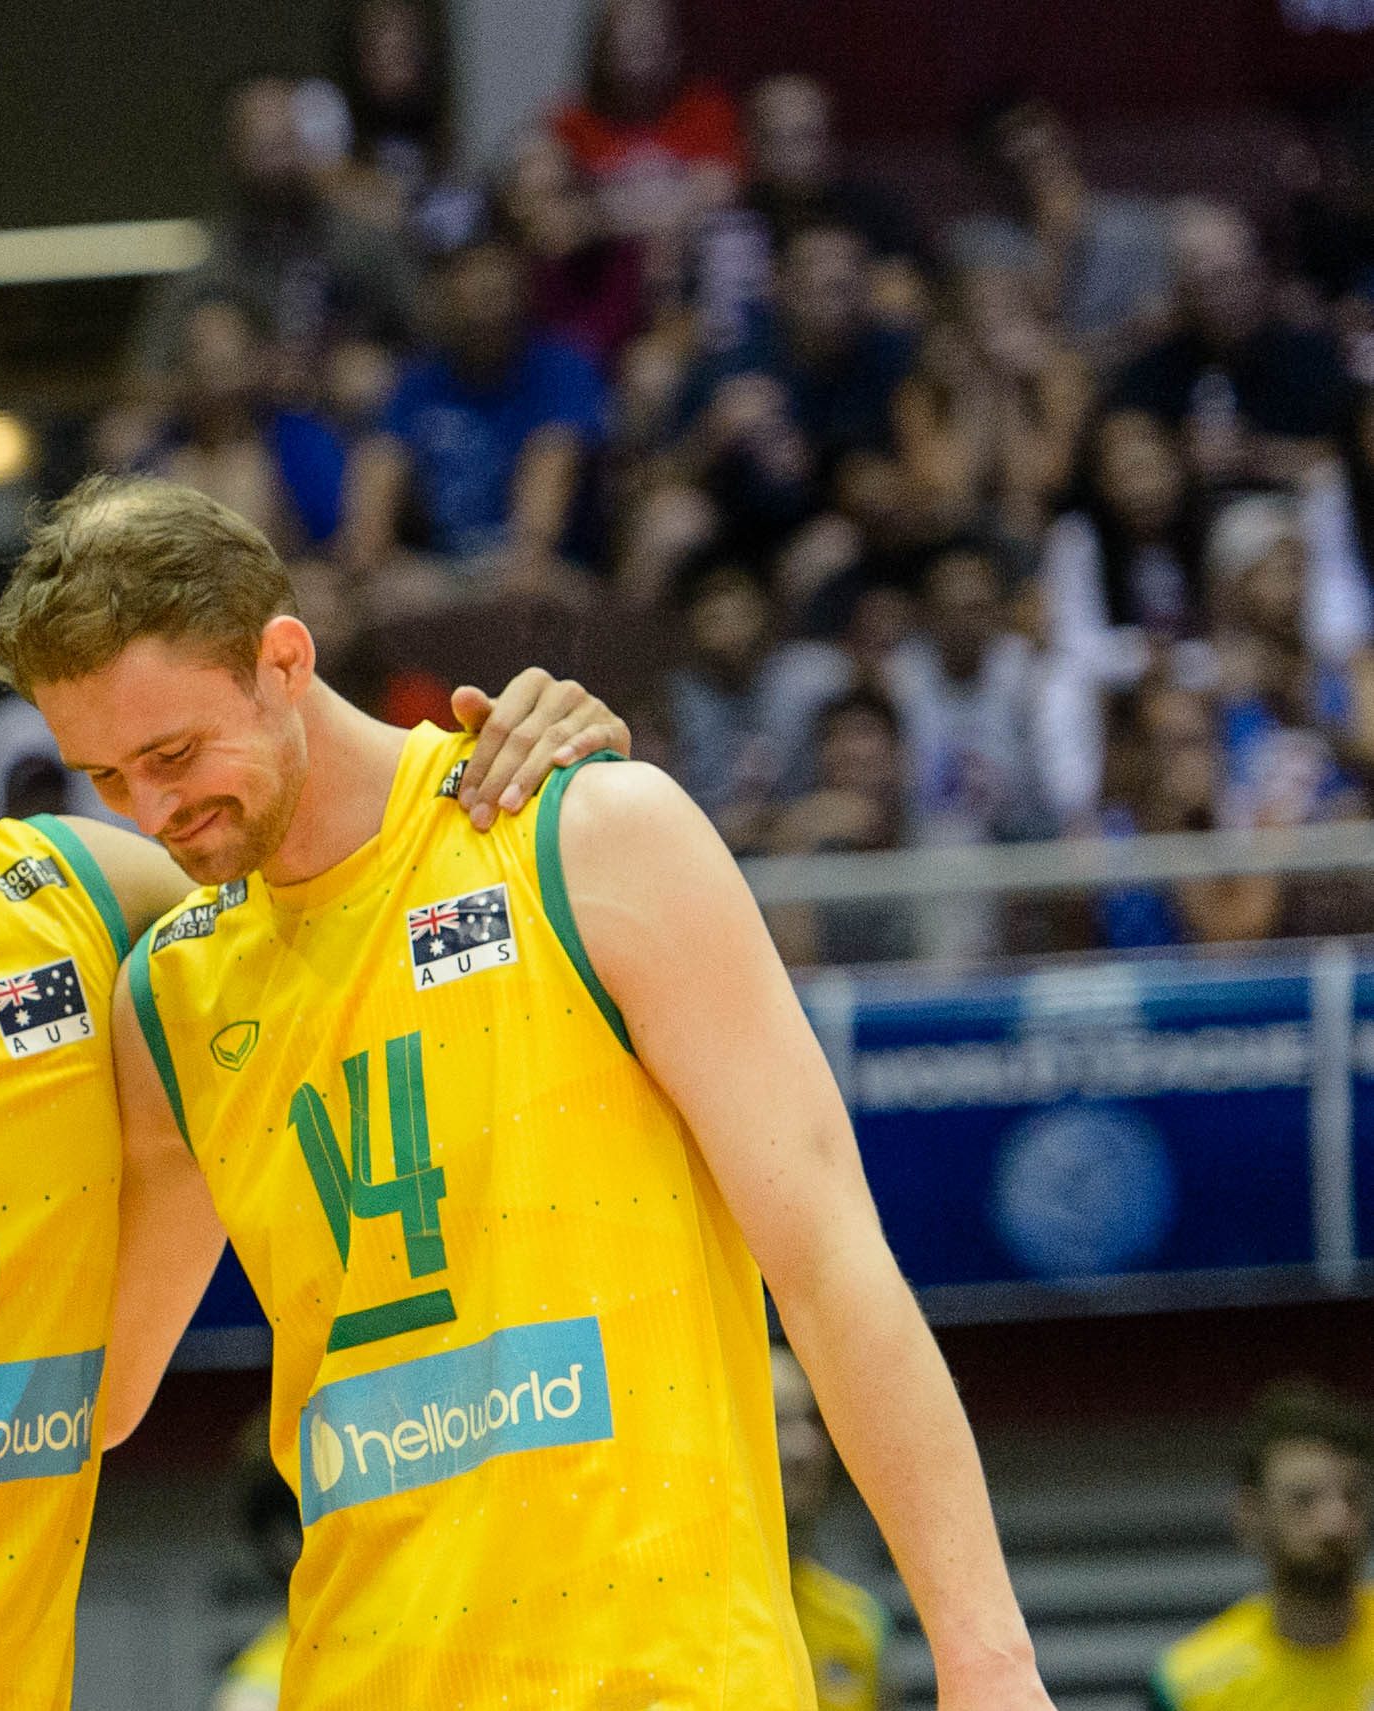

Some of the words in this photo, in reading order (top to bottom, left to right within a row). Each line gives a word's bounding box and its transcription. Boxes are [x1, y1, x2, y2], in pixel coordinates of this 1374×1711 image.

[421, 943, 510, 986] AUS
[13, 1015, 90, 1053] AUS
[287, 1030, 447, 1279] 14
[344, 1363, 583, 1475] helloworld
